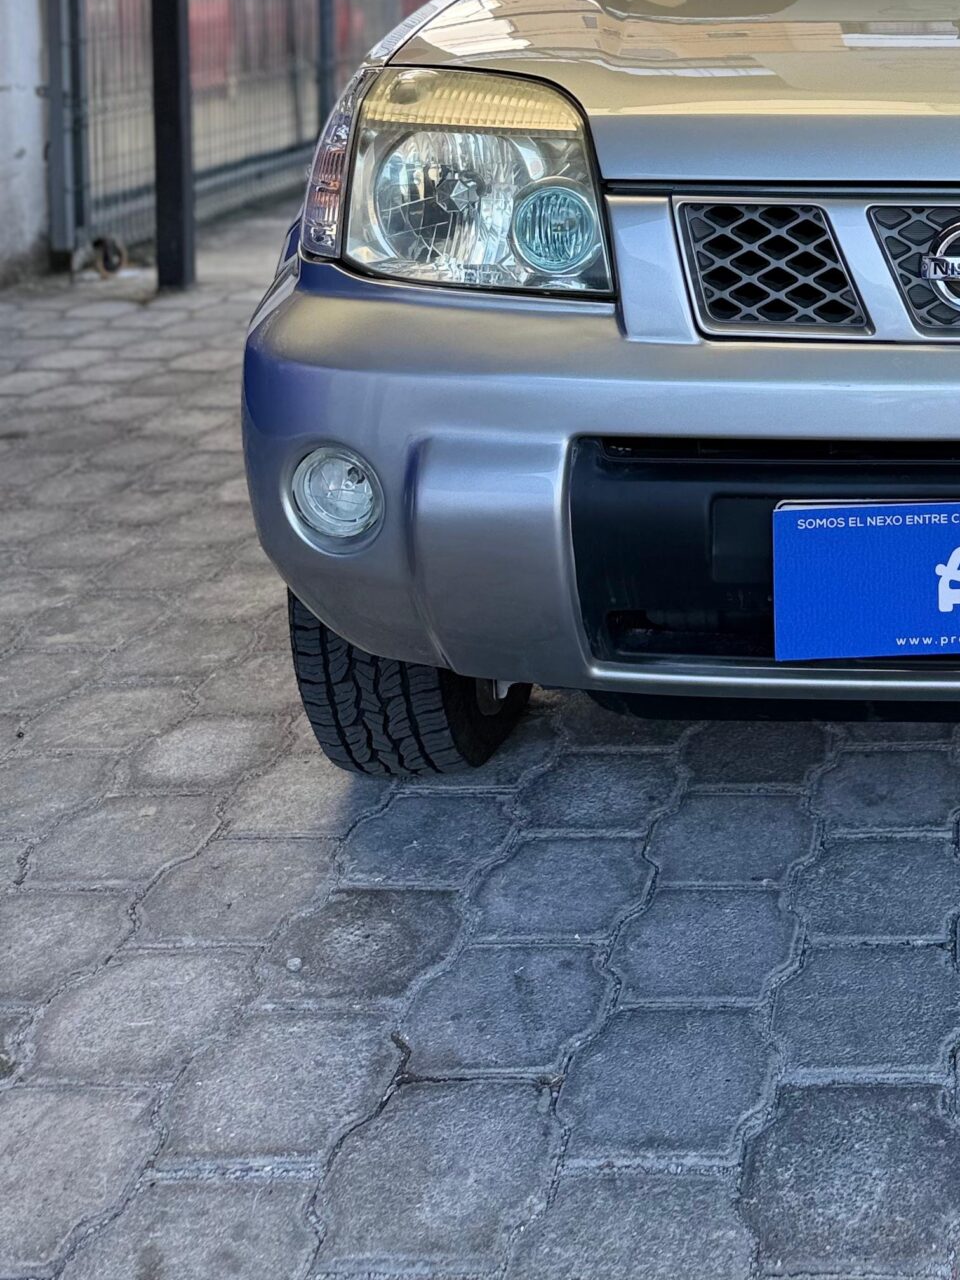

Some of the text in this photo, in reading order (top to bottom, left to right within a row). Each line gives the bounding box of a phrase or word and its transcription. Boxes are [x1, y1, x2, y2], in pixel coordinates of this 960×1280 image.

[797, 517, 846, 530] SOMOS
[848, 517, 864, 528] EL
[867, 515, 903, 526] NEXO
[905, 514, 948, 525] ENTRE
